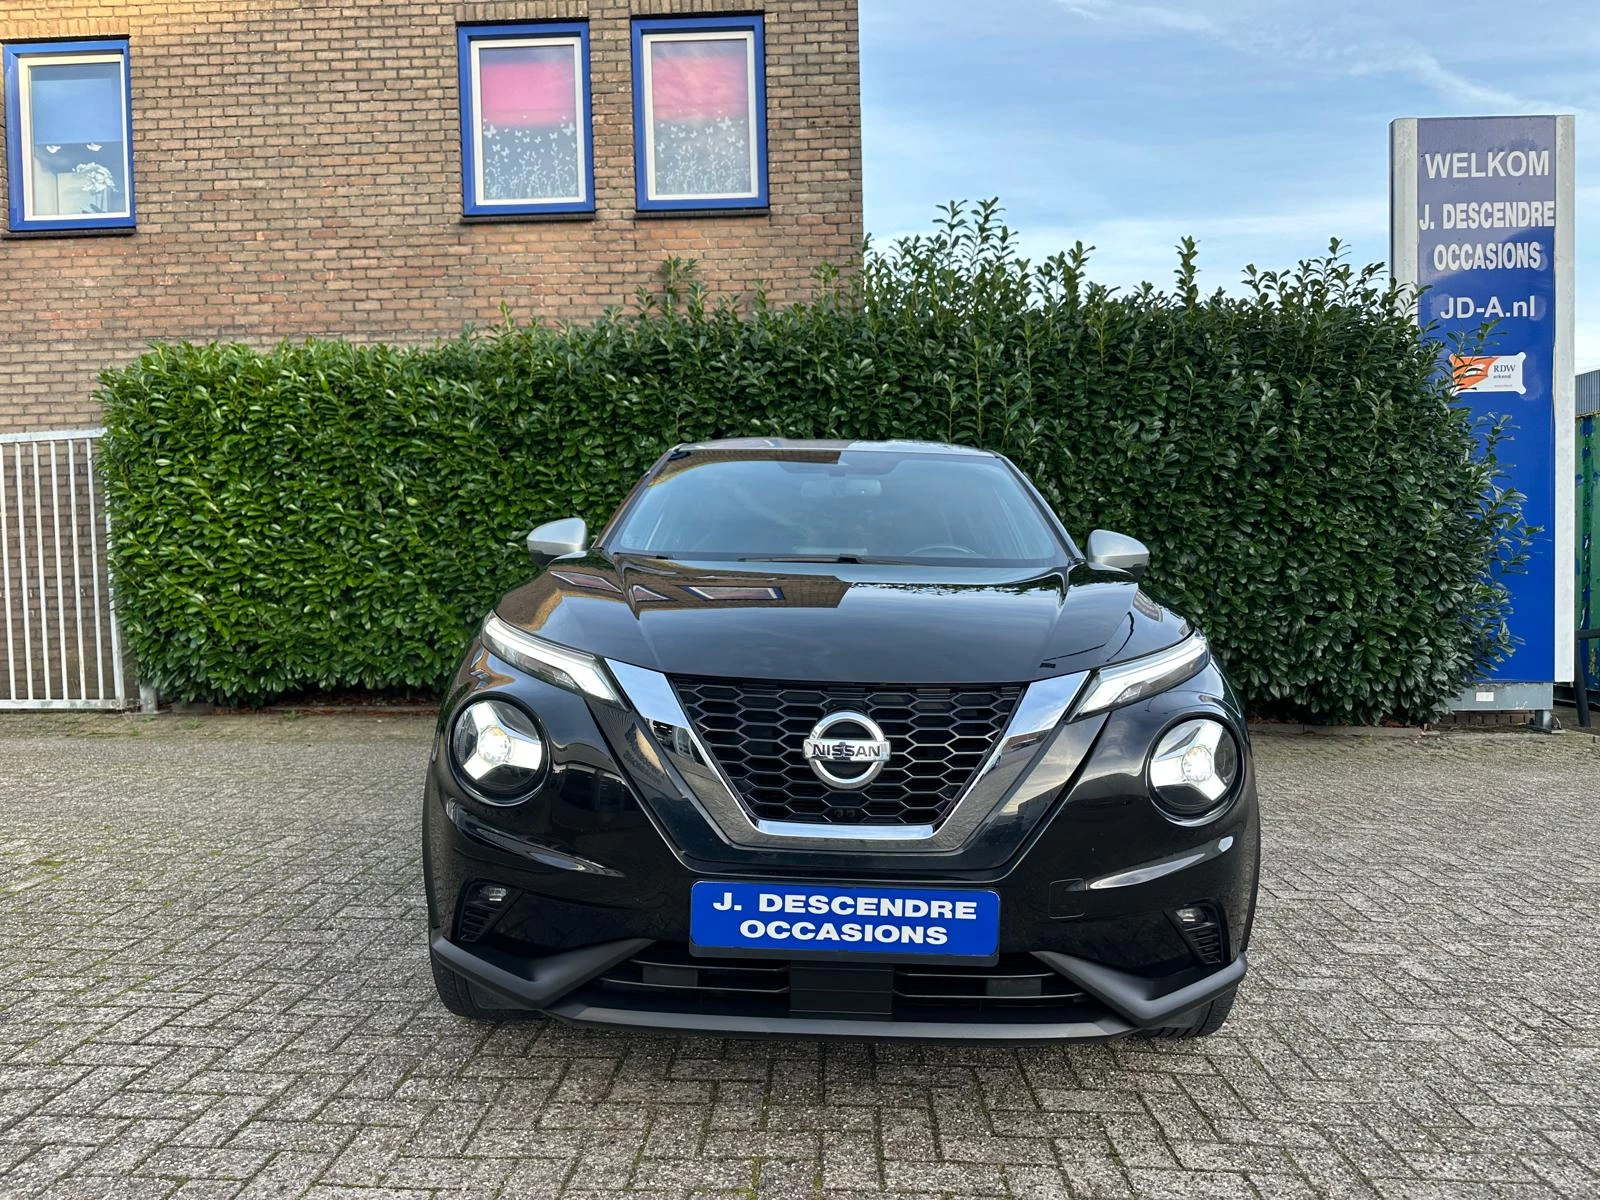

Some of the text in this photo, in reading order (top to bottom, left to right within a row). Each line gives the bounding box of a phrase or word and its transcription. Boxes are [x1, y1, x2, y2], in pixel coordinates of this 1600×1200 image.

[1425, 151, 1549, 178] WELKOM
[1419, 201, 1555, 230] J. DESCENDRE
[1434, 242, 1541, 271] OCCASIONS
[1440, 296, 1535, 319] JD-A.nl
[1493, 364, 1516, 373] RDW
[812, 744, 880, 757] NISSAN
[713, 892, 977, 919] J. DESCENDRE
[740, 920, 948, 945] OCCASIONS
